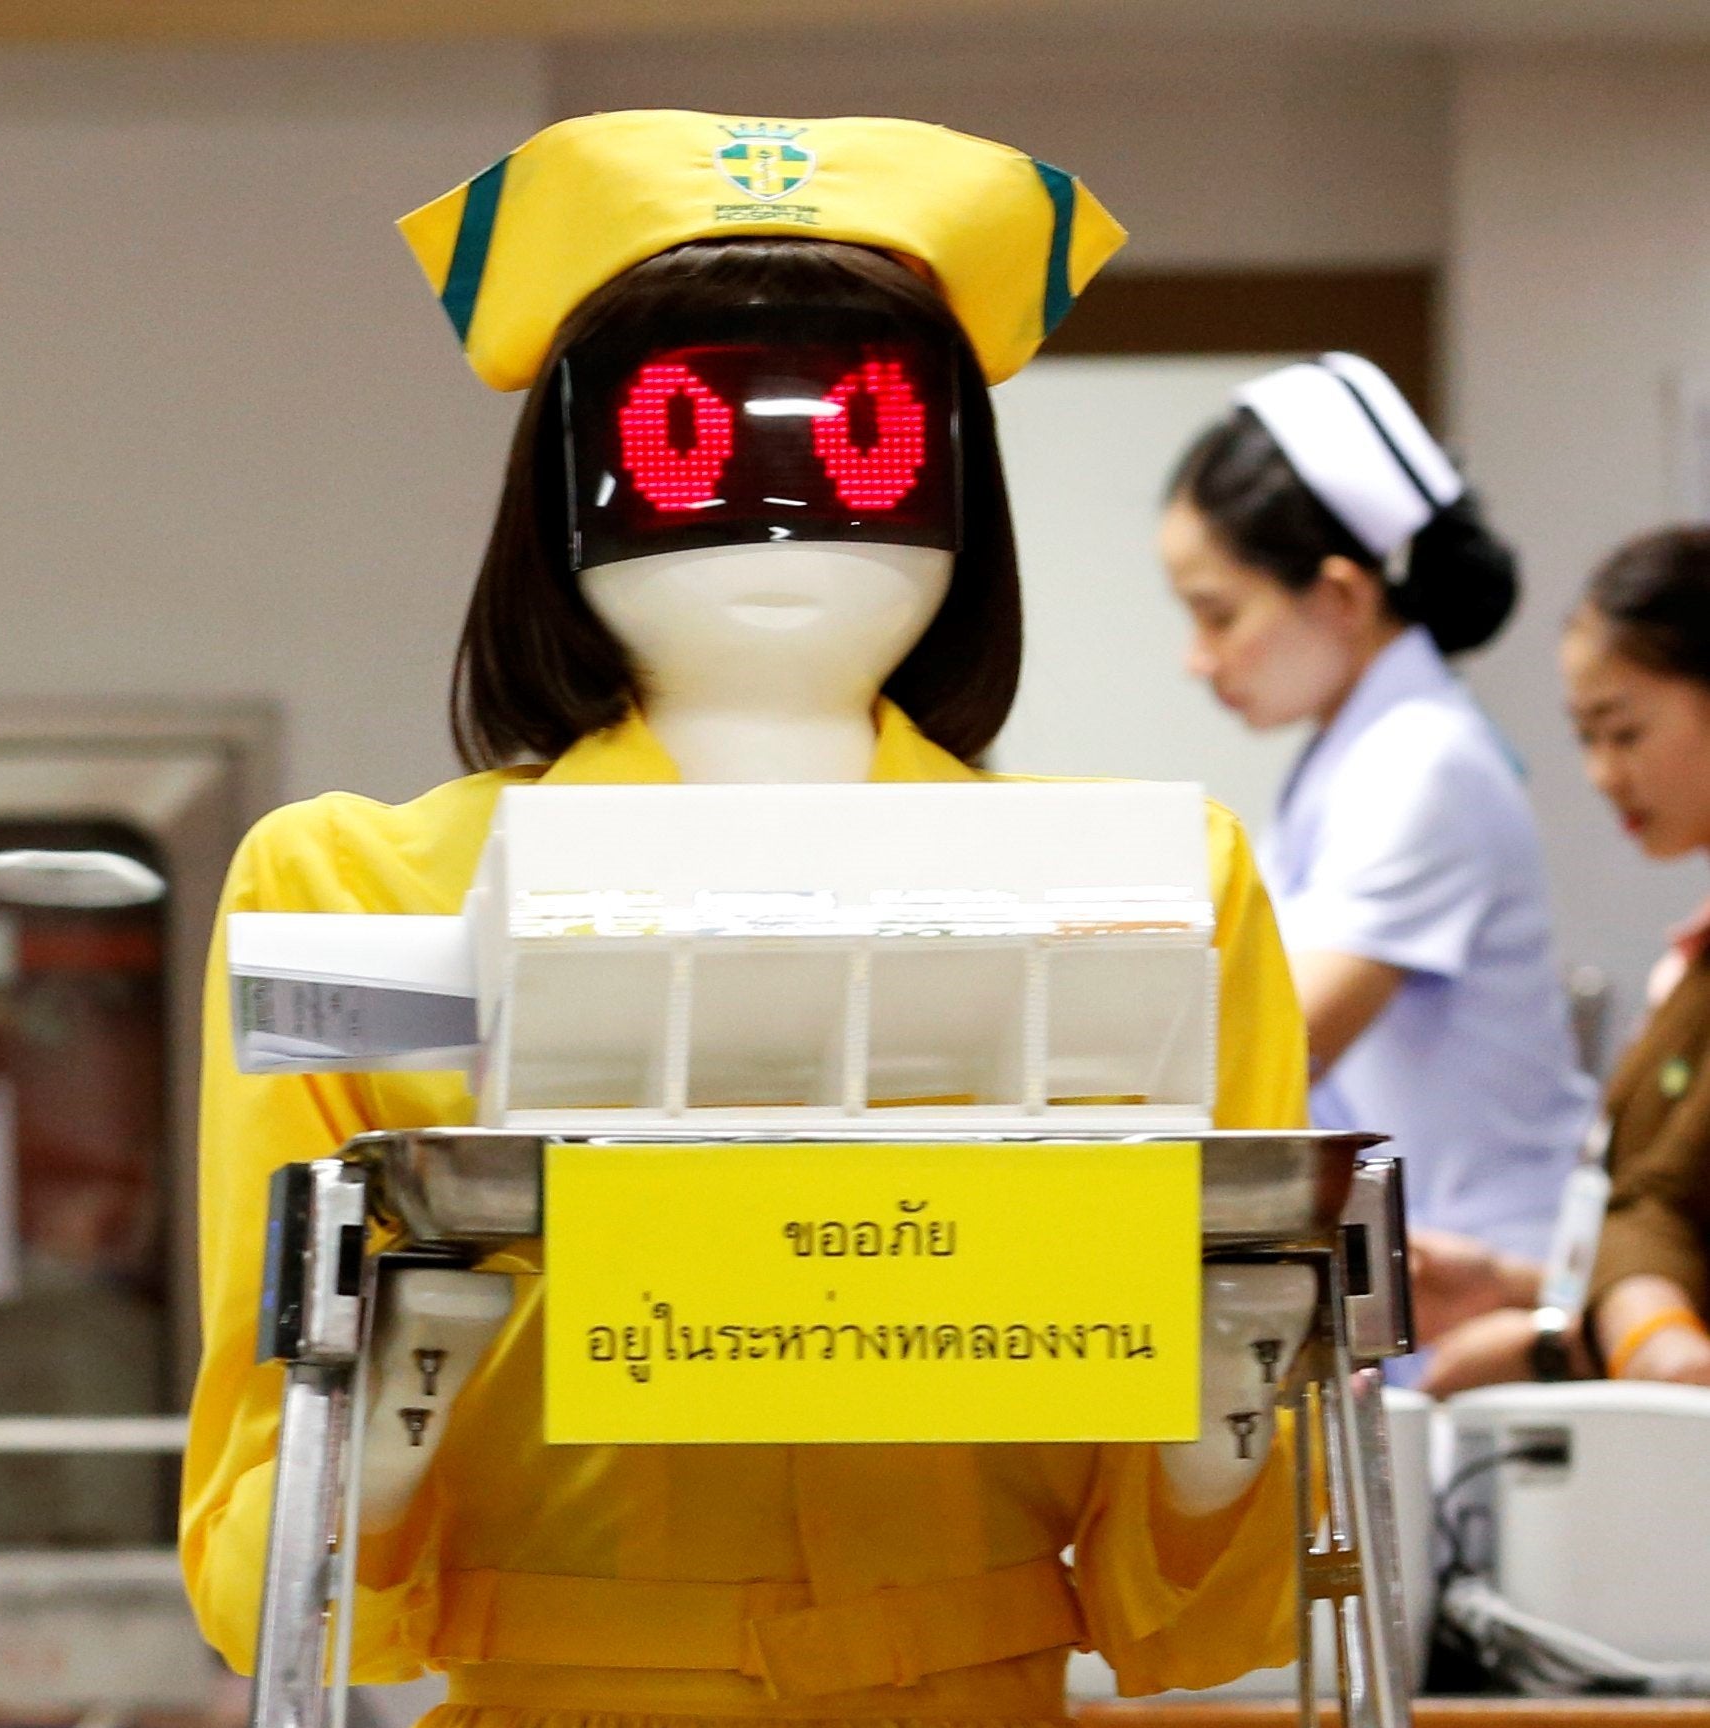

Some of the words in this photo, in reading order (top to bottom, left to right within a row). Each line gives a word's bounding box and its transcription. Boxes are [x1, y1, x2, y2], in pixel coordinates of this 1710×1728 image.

[715, 211, 821, 225] HOSPITAL
[783, 1200, 957, 1258] ขออภัย
[587, 1291, 1156, 1384] อยู่ในระหว่างทดลองงาน
